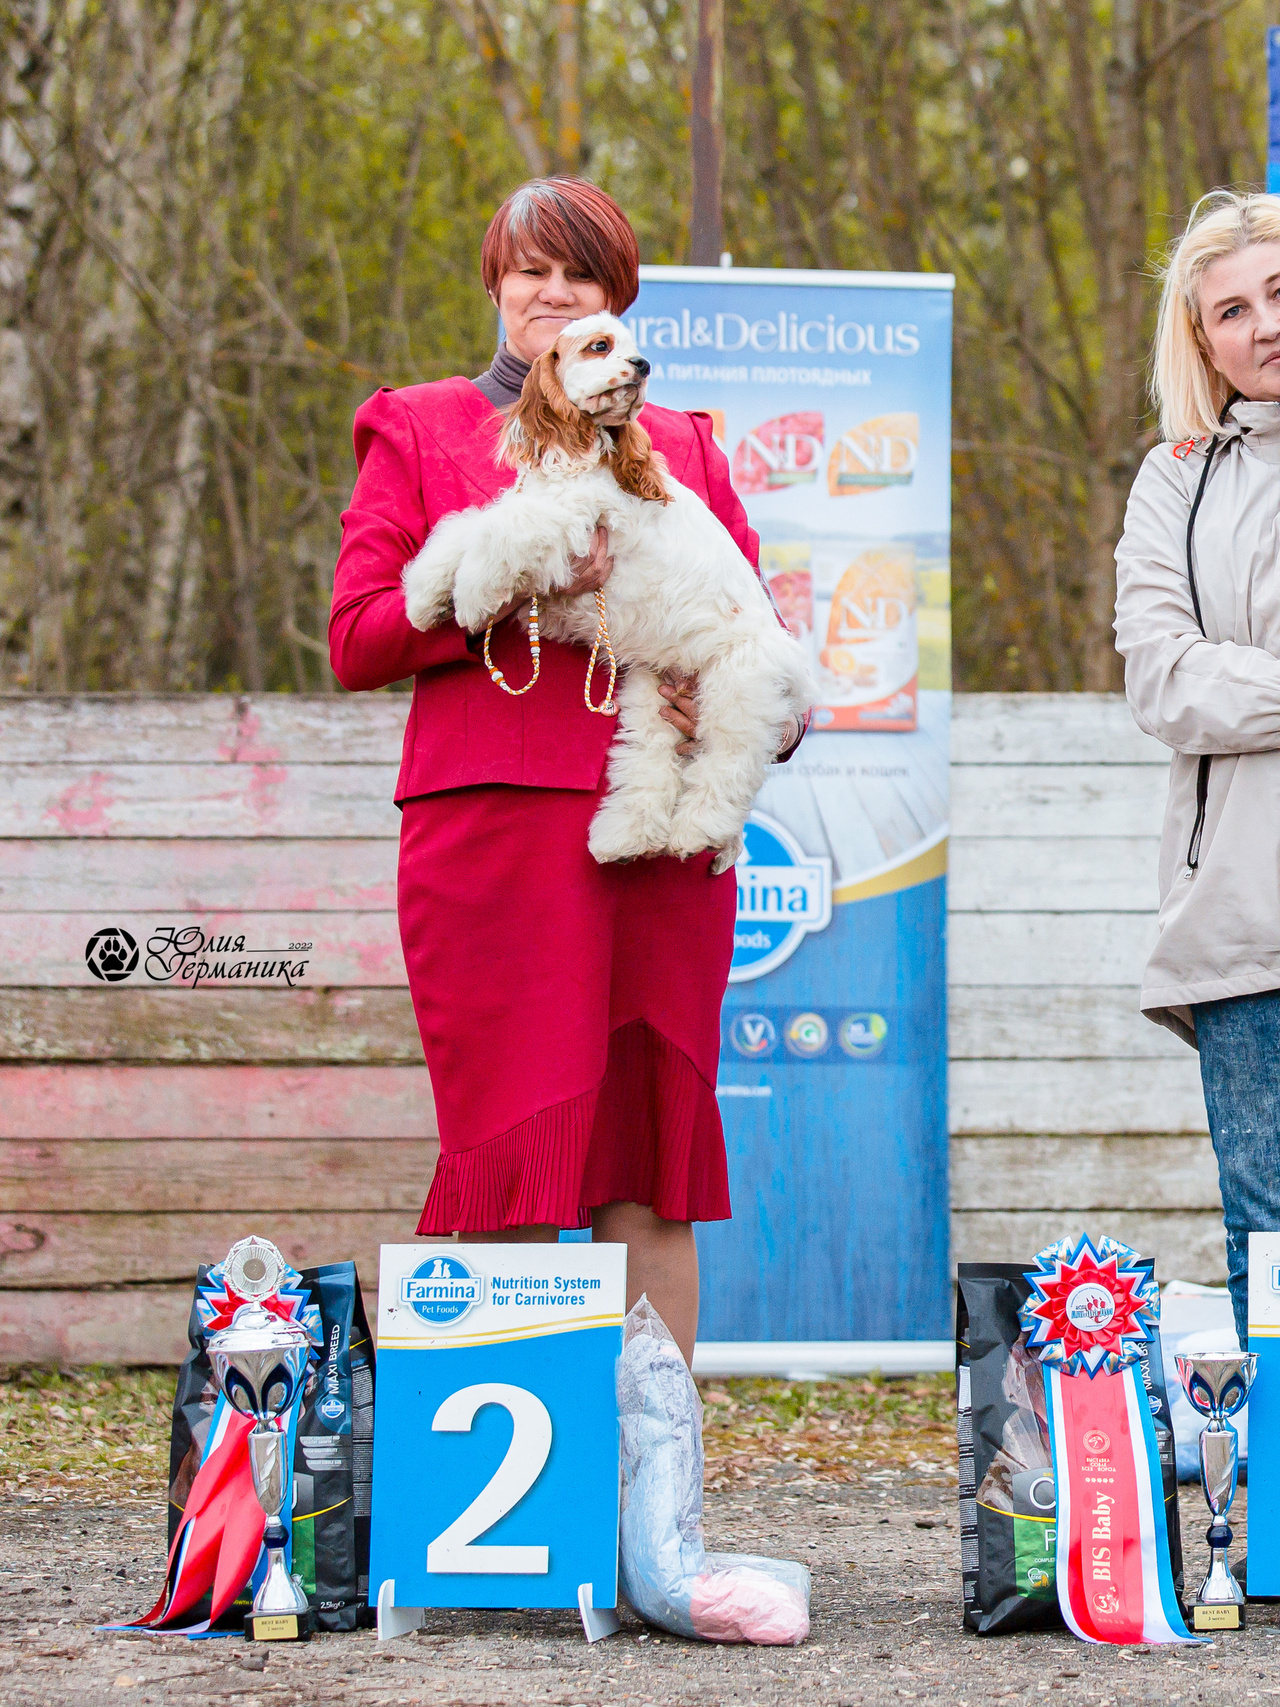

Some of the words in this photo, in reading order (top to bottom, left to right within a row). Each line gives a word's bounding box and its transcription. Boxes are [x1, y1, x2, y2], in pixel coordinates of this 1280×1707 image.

[406, 1281, 475, 1299] Farmina
[492, 1276, 549, 1290] Nutrition
[553, 1276, 601, 1294] System
[492, 1293, 510, 1306] for
[515, 1293, 586, 1306] Carnivores
[422, 1304, 435, 1314] Pet
[436, 1304, 459, 1314] Foods
[328, 1324, 341, 1362] BREED
[328, 1363, 340, 1395] MAXI
[1140, 1360, 1153, 1390] MAXI
[426, 1382, 553, 1574] 2
[1092, 1490, 1115, 1540] Baby
[1092, 1546, 1112, 1581] BIS
